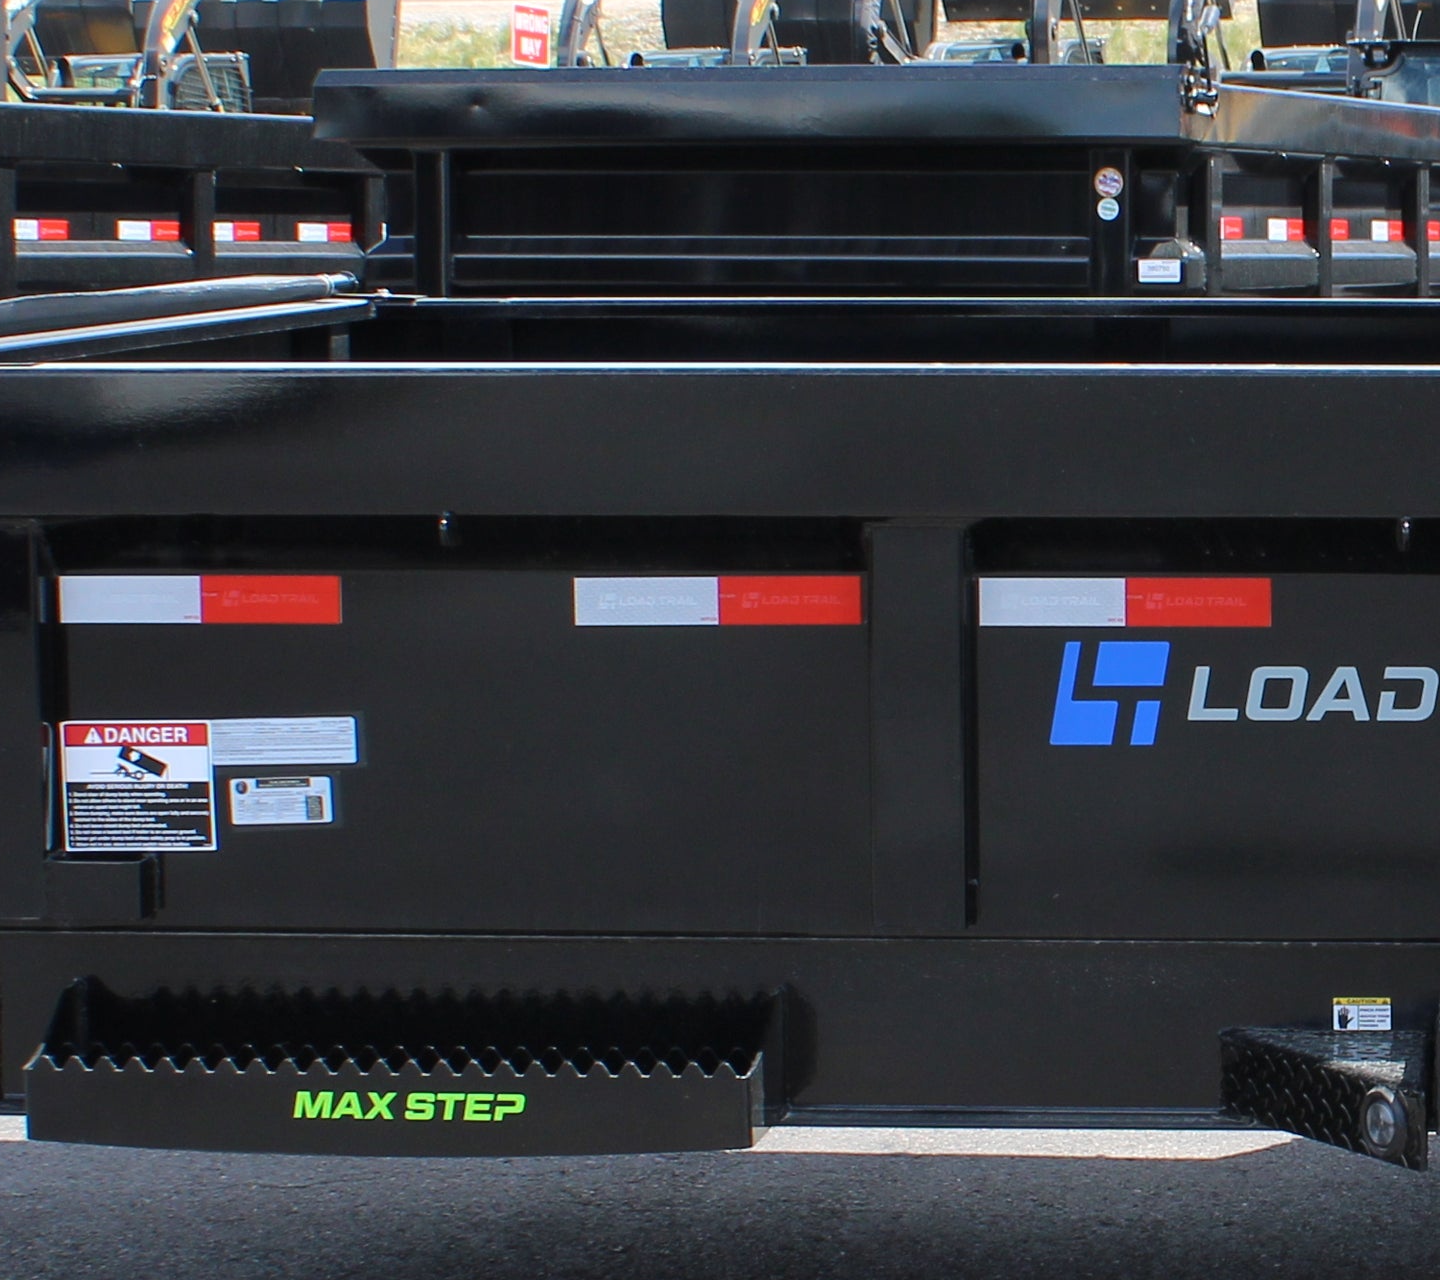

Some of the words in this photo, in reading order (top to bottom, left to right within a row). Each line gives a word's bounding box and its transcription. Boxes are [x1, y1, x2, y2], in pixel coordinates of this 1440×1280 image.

[515, 13, 549, 34] WRONG
[521, 36, 542, 57] WAY
[1187, 666, 1440, 721] LOAD
[104, 726, 188, 743] DANGER
[293, 1091, 397, 1119] MAX
[405, 1093, 526, 1122] STEP
